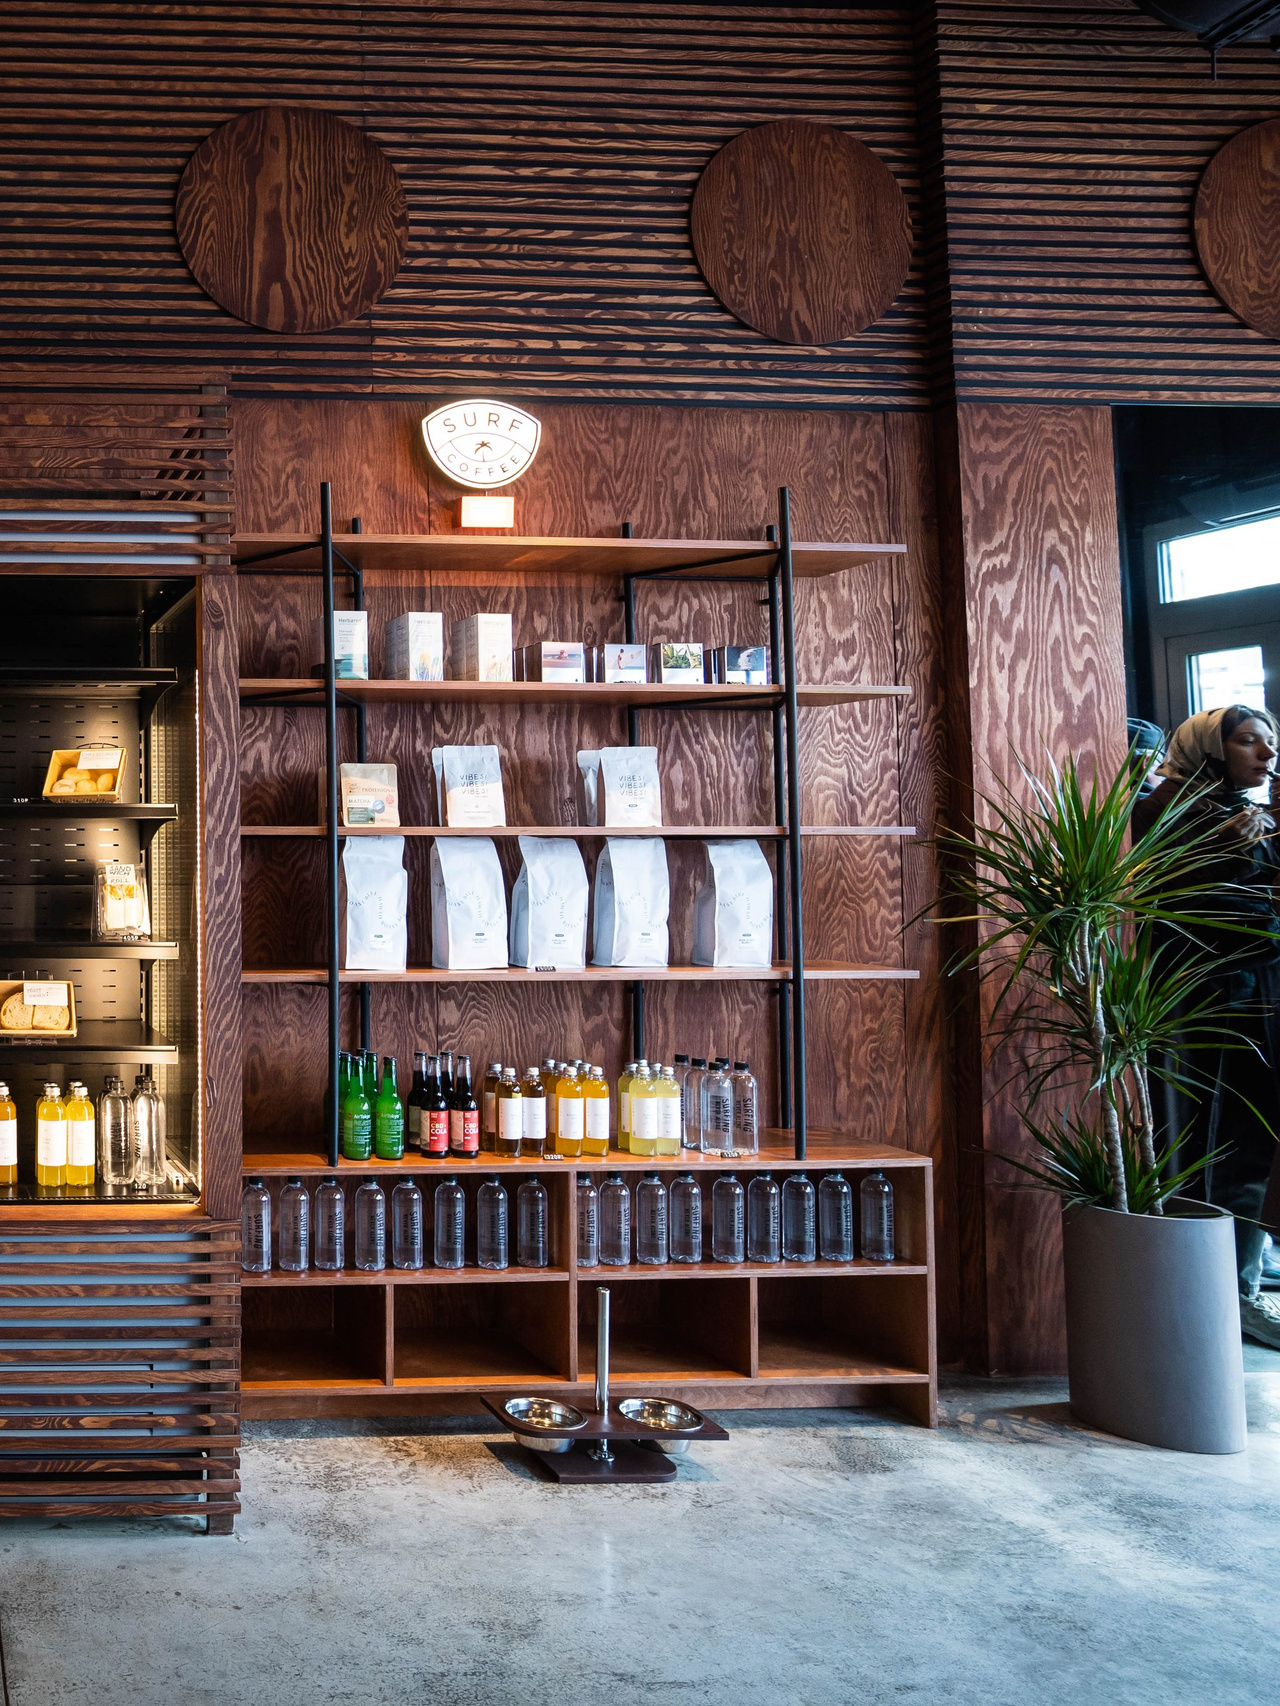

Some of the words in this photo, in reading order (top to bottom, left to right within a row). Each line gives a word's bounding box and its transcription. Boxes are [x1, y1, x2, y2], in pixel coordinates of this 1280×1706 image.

[443, 411, 523, 433] SURF
[447, 453, 520, 477] COFFEE
[743, 1098, 753, 1132] SURFING
[253, 1214, 263, 1249] SURFING
[334, 1211, 342, 1246] SURFING
[410, 1211, 419, 1246] SURFING
[453, 1211, 462, 1245] SURFING
[497, 1212, 505, 1246] SURFING
[586, 1209, 595, 1244] SURFING
[657, 1207, 665, 1241] SURFING
[691, 1206, 700, 1239] SURFING
